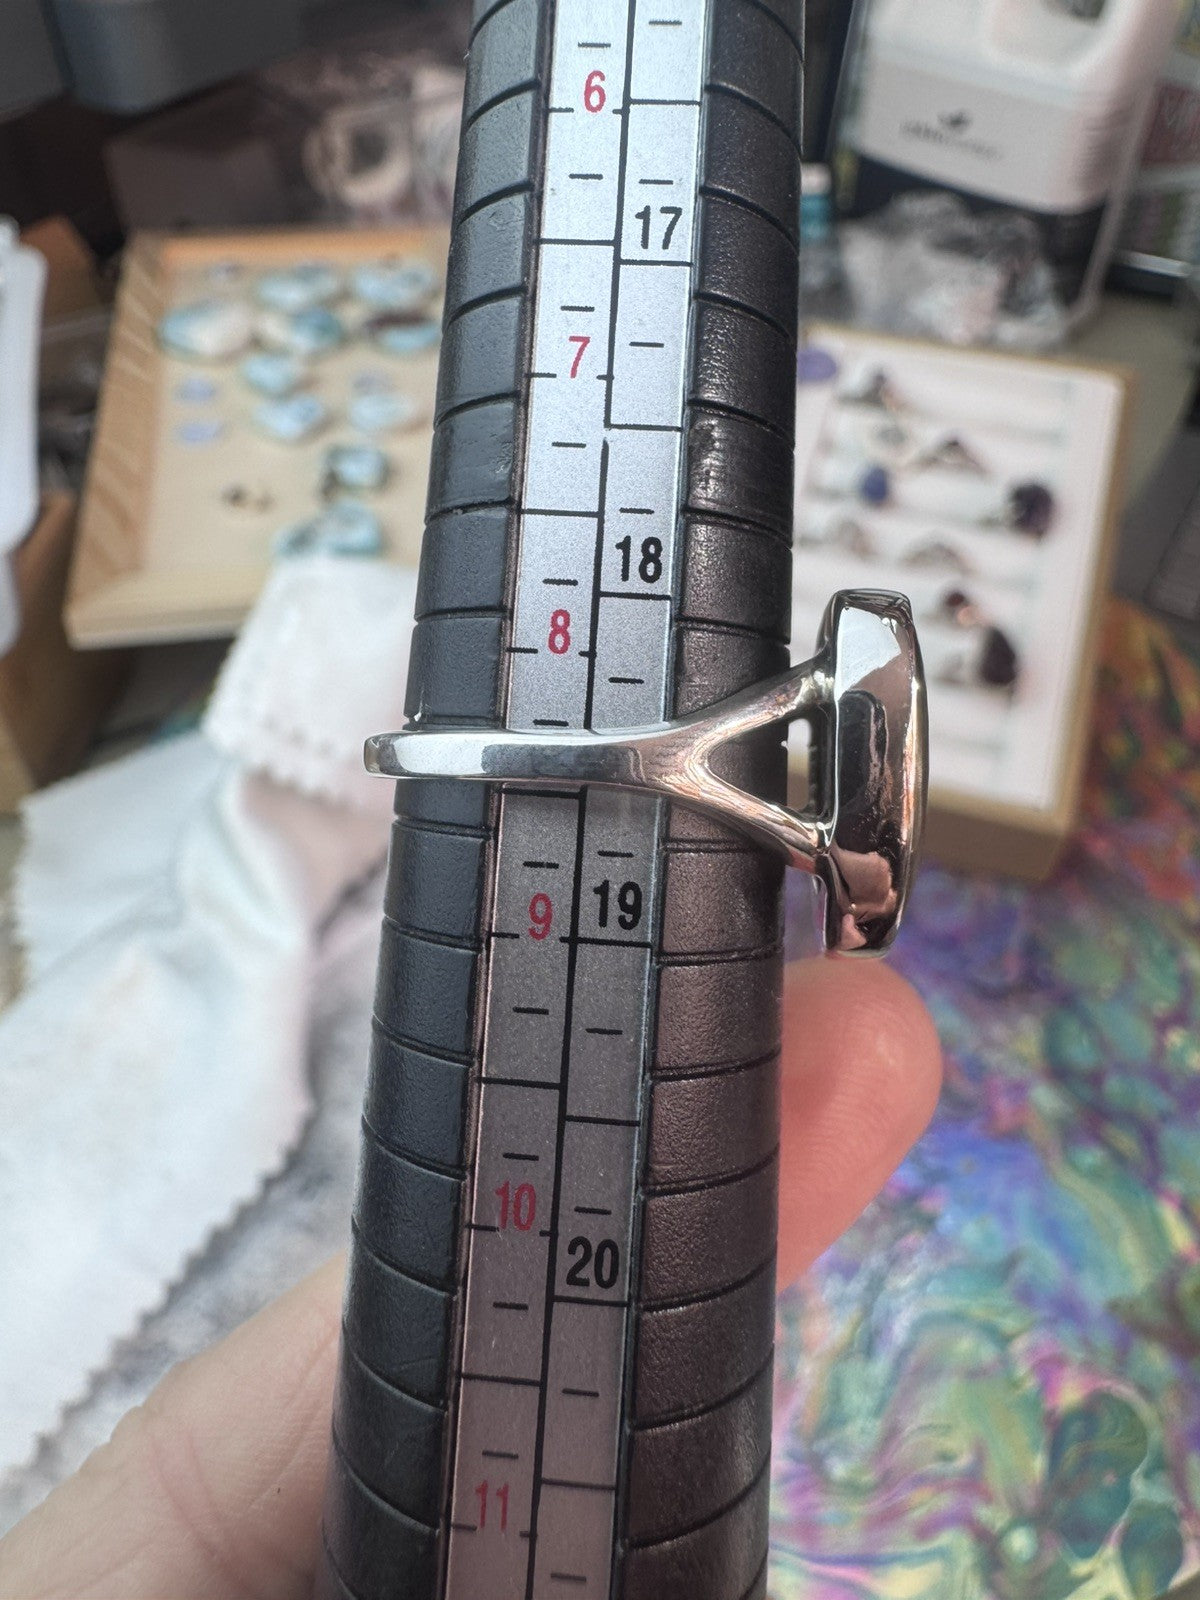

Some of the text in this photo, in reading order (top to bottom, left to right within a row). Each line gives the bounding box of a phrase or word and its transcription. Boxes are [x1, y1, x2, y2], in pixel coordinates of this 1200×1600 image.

[583, 70, 606, 112] 6
[635, 205, 682, 250] 17
[568, 336, 590, 378] 7
[615, 535, 663, 583] 18
[548, 609, 571, 654] 8
[528, 892, 553, 941] 9
[593, 879, 643, 930] 19
[495, 1180, 536, 1231] 10
[566, 1236, 620, 1289] 20
[475, 1479, 509, 1533] 11
